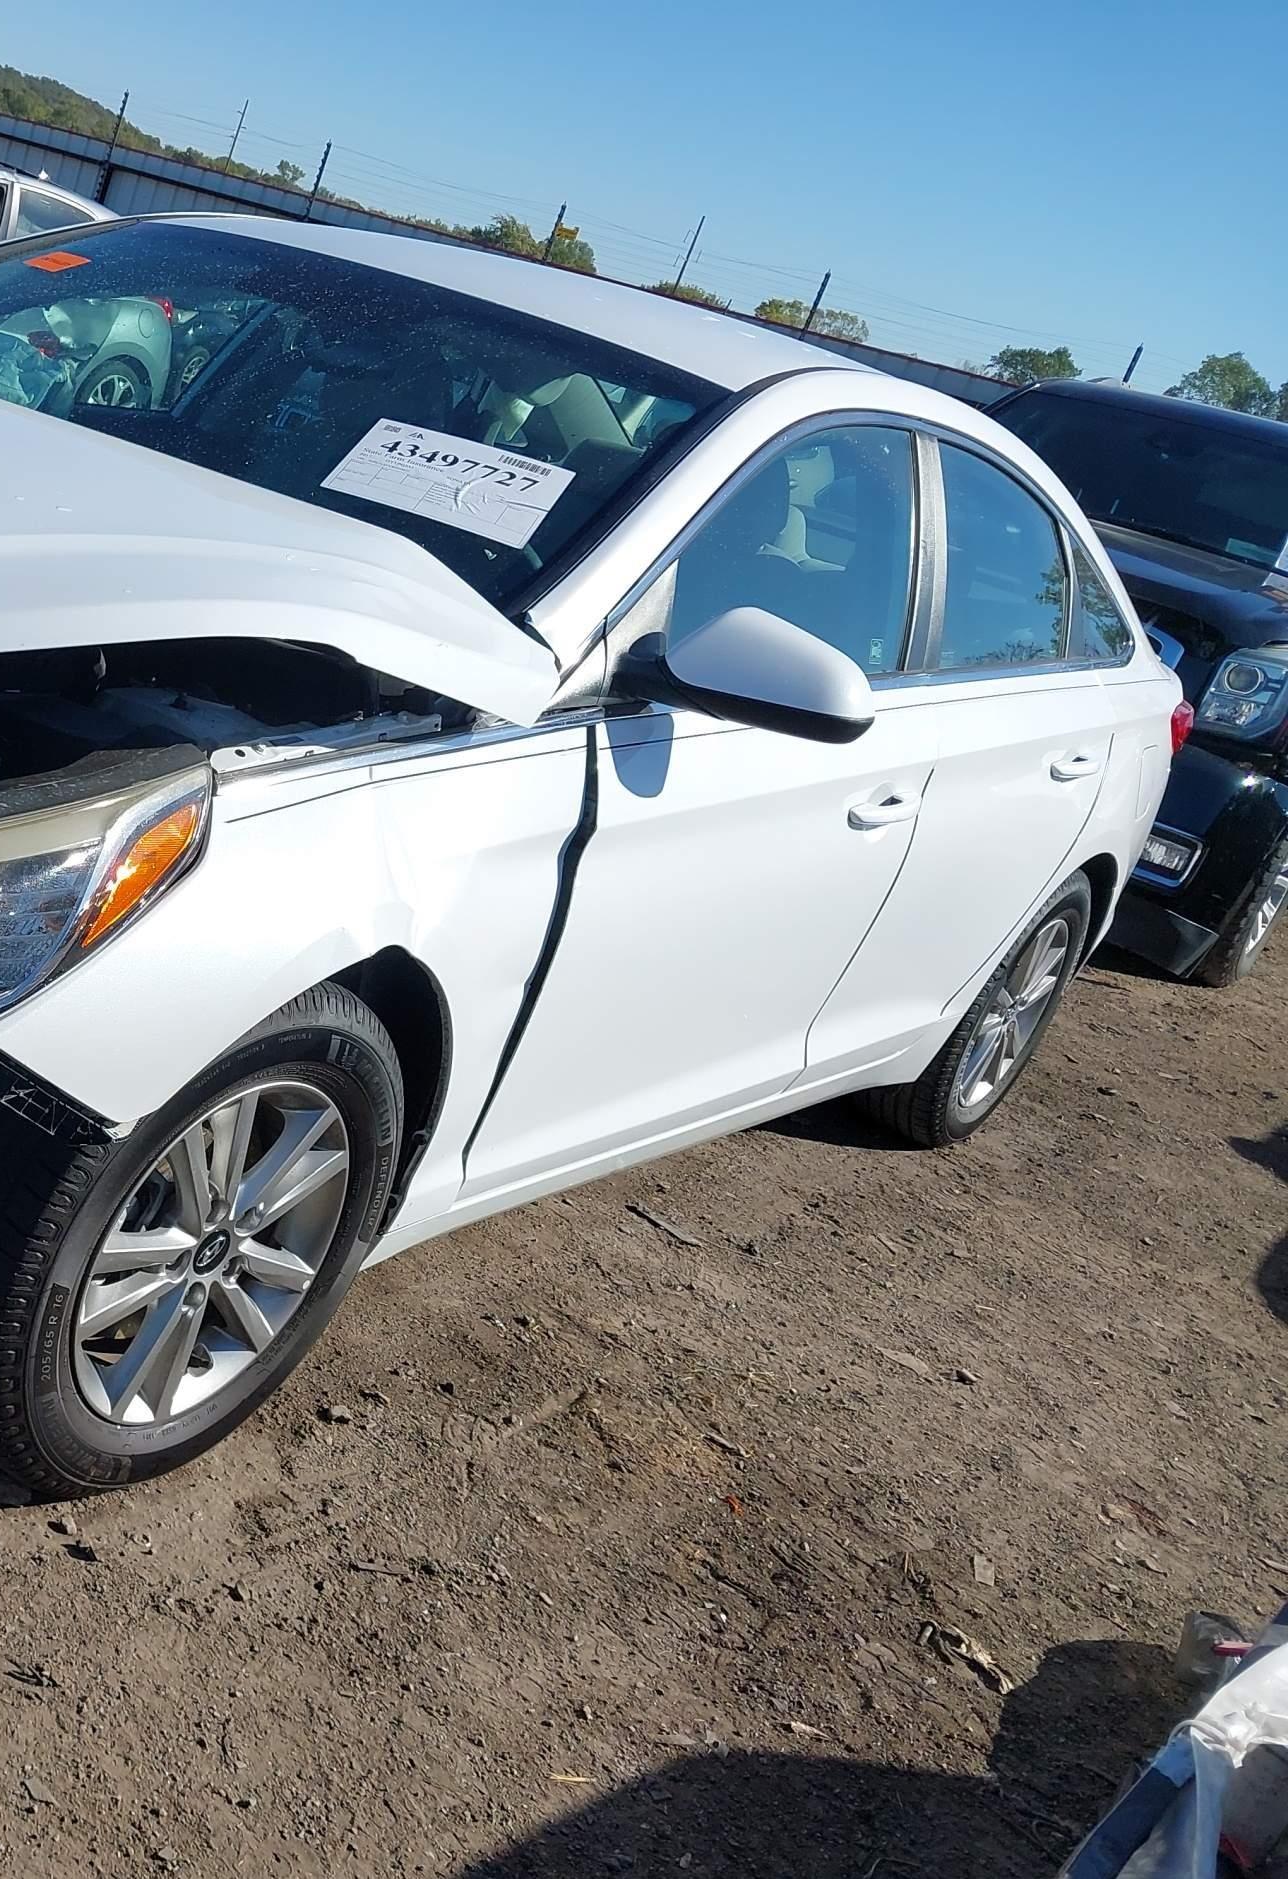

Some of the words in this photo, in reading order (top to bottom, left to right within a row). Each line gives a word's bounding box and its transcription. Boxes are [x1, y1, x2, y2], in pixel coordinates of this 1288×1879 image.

[380, 440, 540, 491] 43497727
[368, 1156, 389, 1228] DEFENDER
[40, 1330, 56, 1381] 205/65
[48, 1315, 58, 1326] R
[55, 1293, 64, 1309] 16
